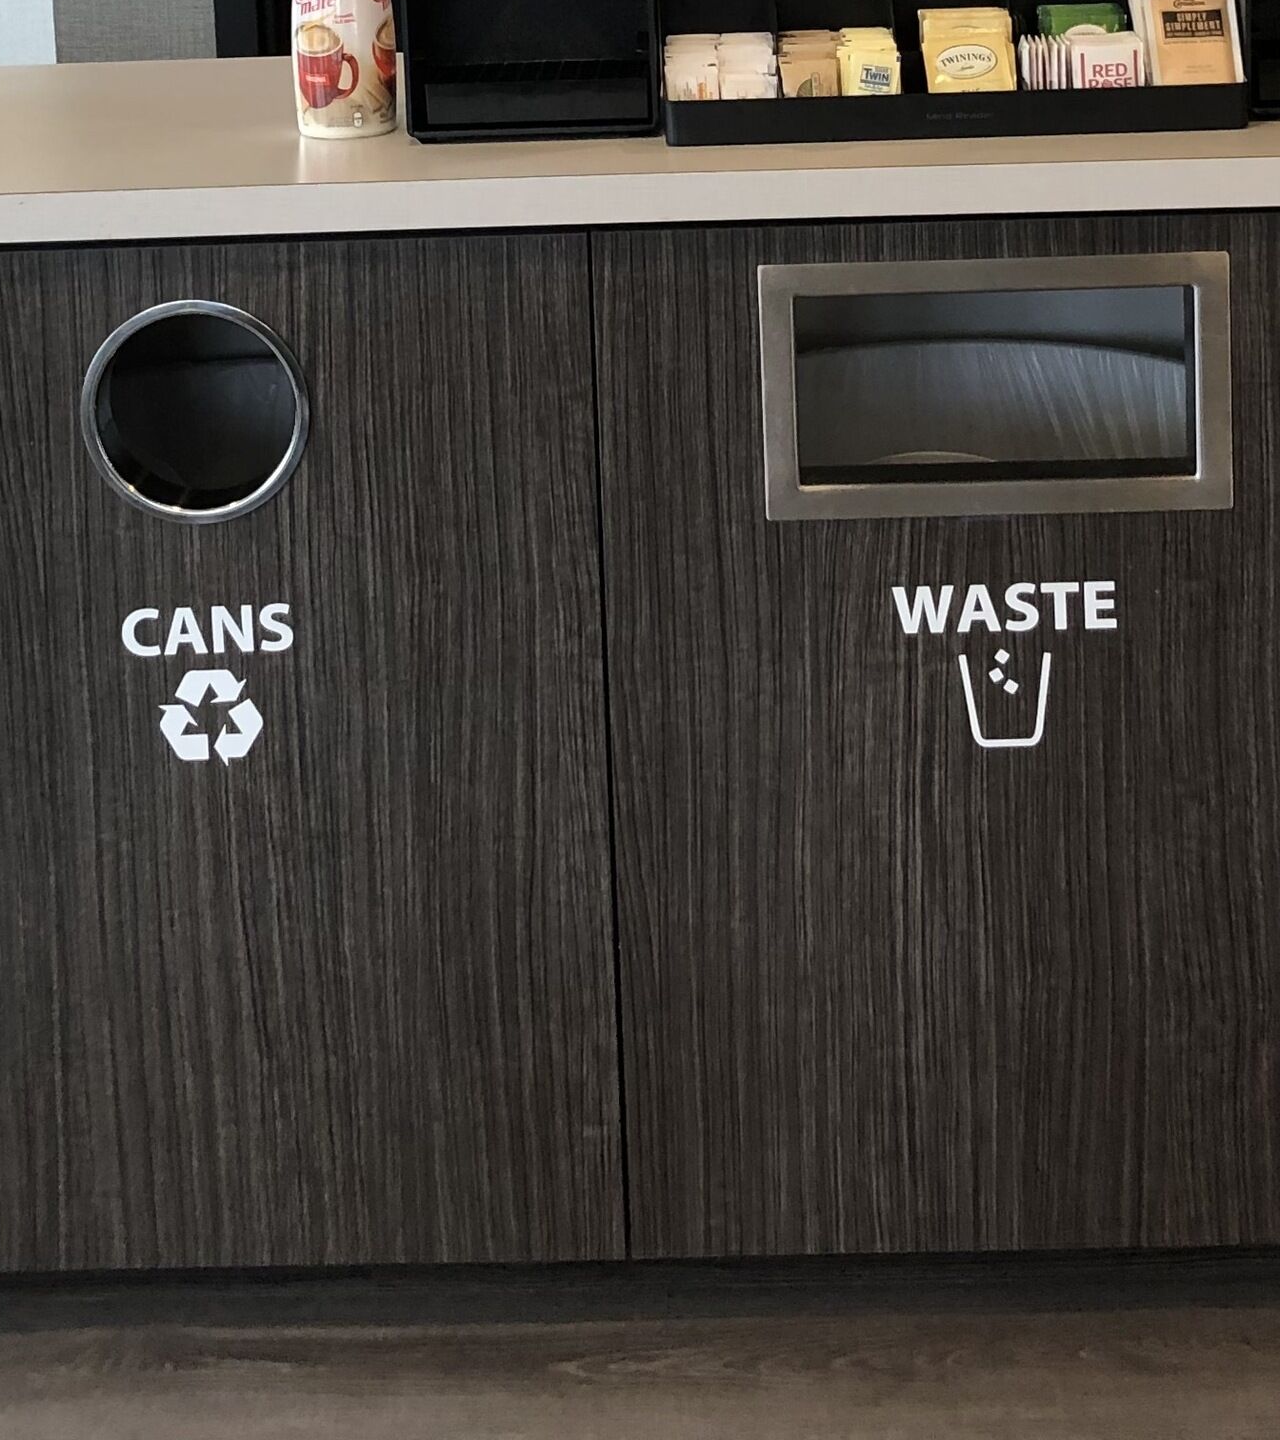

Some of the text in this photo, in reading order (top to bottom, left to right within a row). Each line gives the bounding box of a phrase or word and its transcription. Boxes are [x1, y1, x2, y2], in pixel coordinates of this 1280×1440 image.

[1176, 11, 1207, 22] SIMPLY
[1165, 19, 1221, 32] SIMPLEMENT
[1092, 63, 1128, 78] RED
[891, 580, 1118, 634] WASTE
[121, 602, 294, 657] CANS
